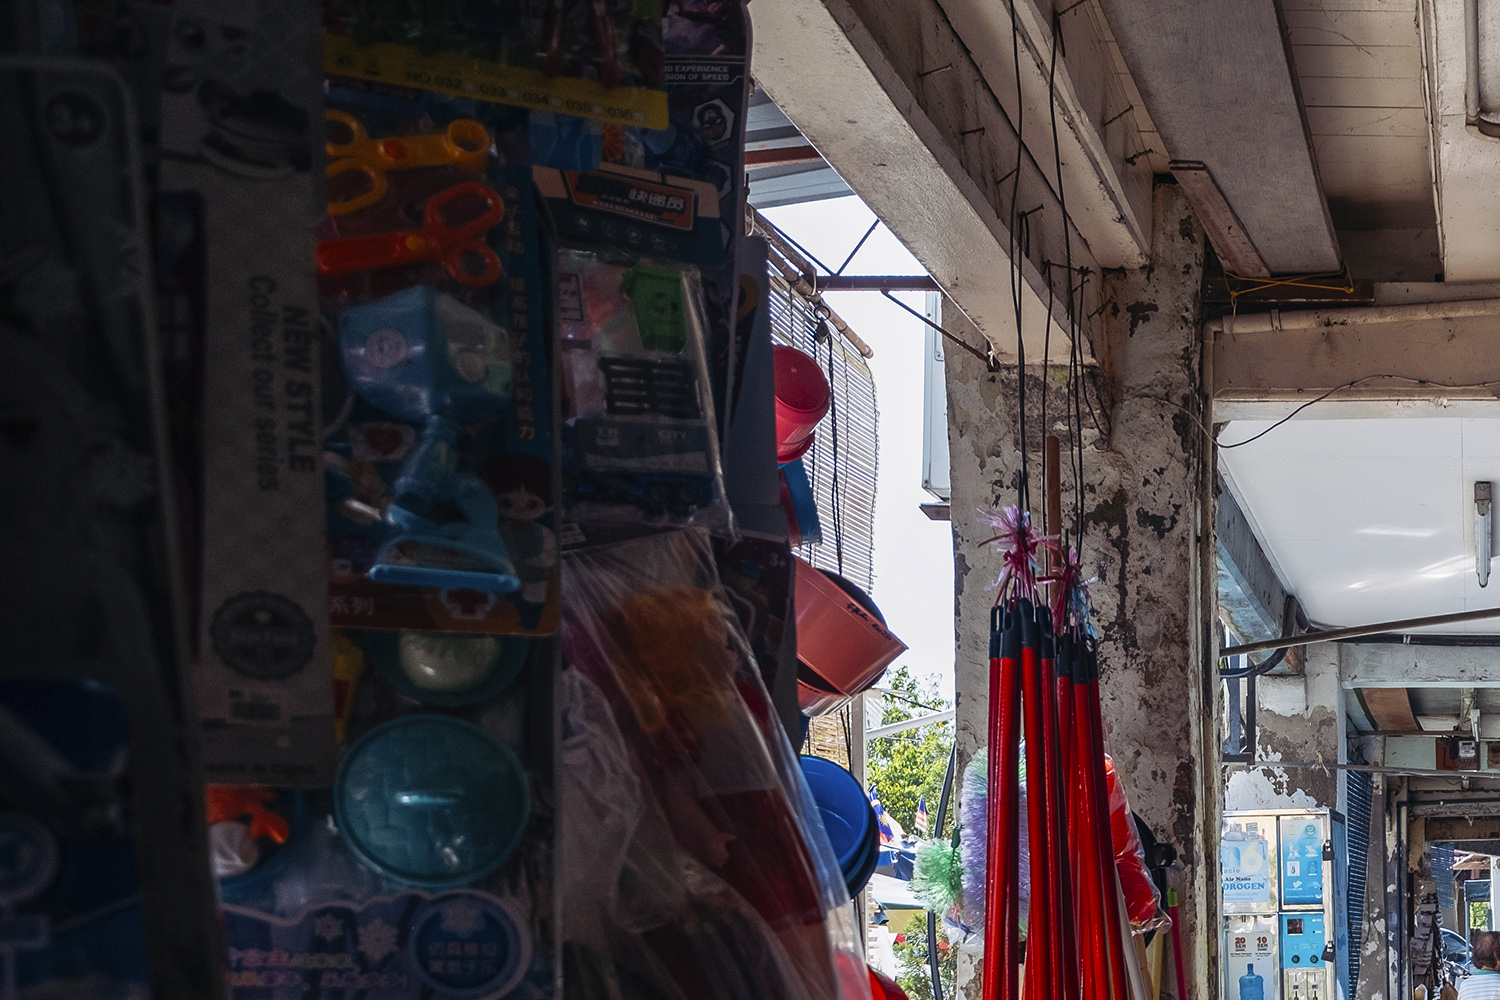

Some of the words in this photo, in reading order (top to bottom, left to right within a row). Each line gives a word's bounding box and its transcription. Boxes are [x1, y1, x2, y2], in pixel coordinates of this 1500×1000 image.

[666, 73, 681, 81] SION
[686, 73, 697, 81] OF
[702, 72, 730, 81] SPEED
[674, 64, 730, 74] EXPERIENCE
[478, 82, 507, 97] 033
[521, 90, 549, 105] 034
[566, 98, 592, 113] 035
[607, 106, 634, 120] 036
[250, 275, 278, 362] Collect
[283, 305, 312, 373] NEW
[252, 368, 276, 412] our
[285, 379, 316, 473] STYLE
[253, 416, 279, 490] series
[1222, 882, 1265, 891] DROGEN
[1223, 865, 1241, 874] acle
[1256, 936, 1267, 944] 10
